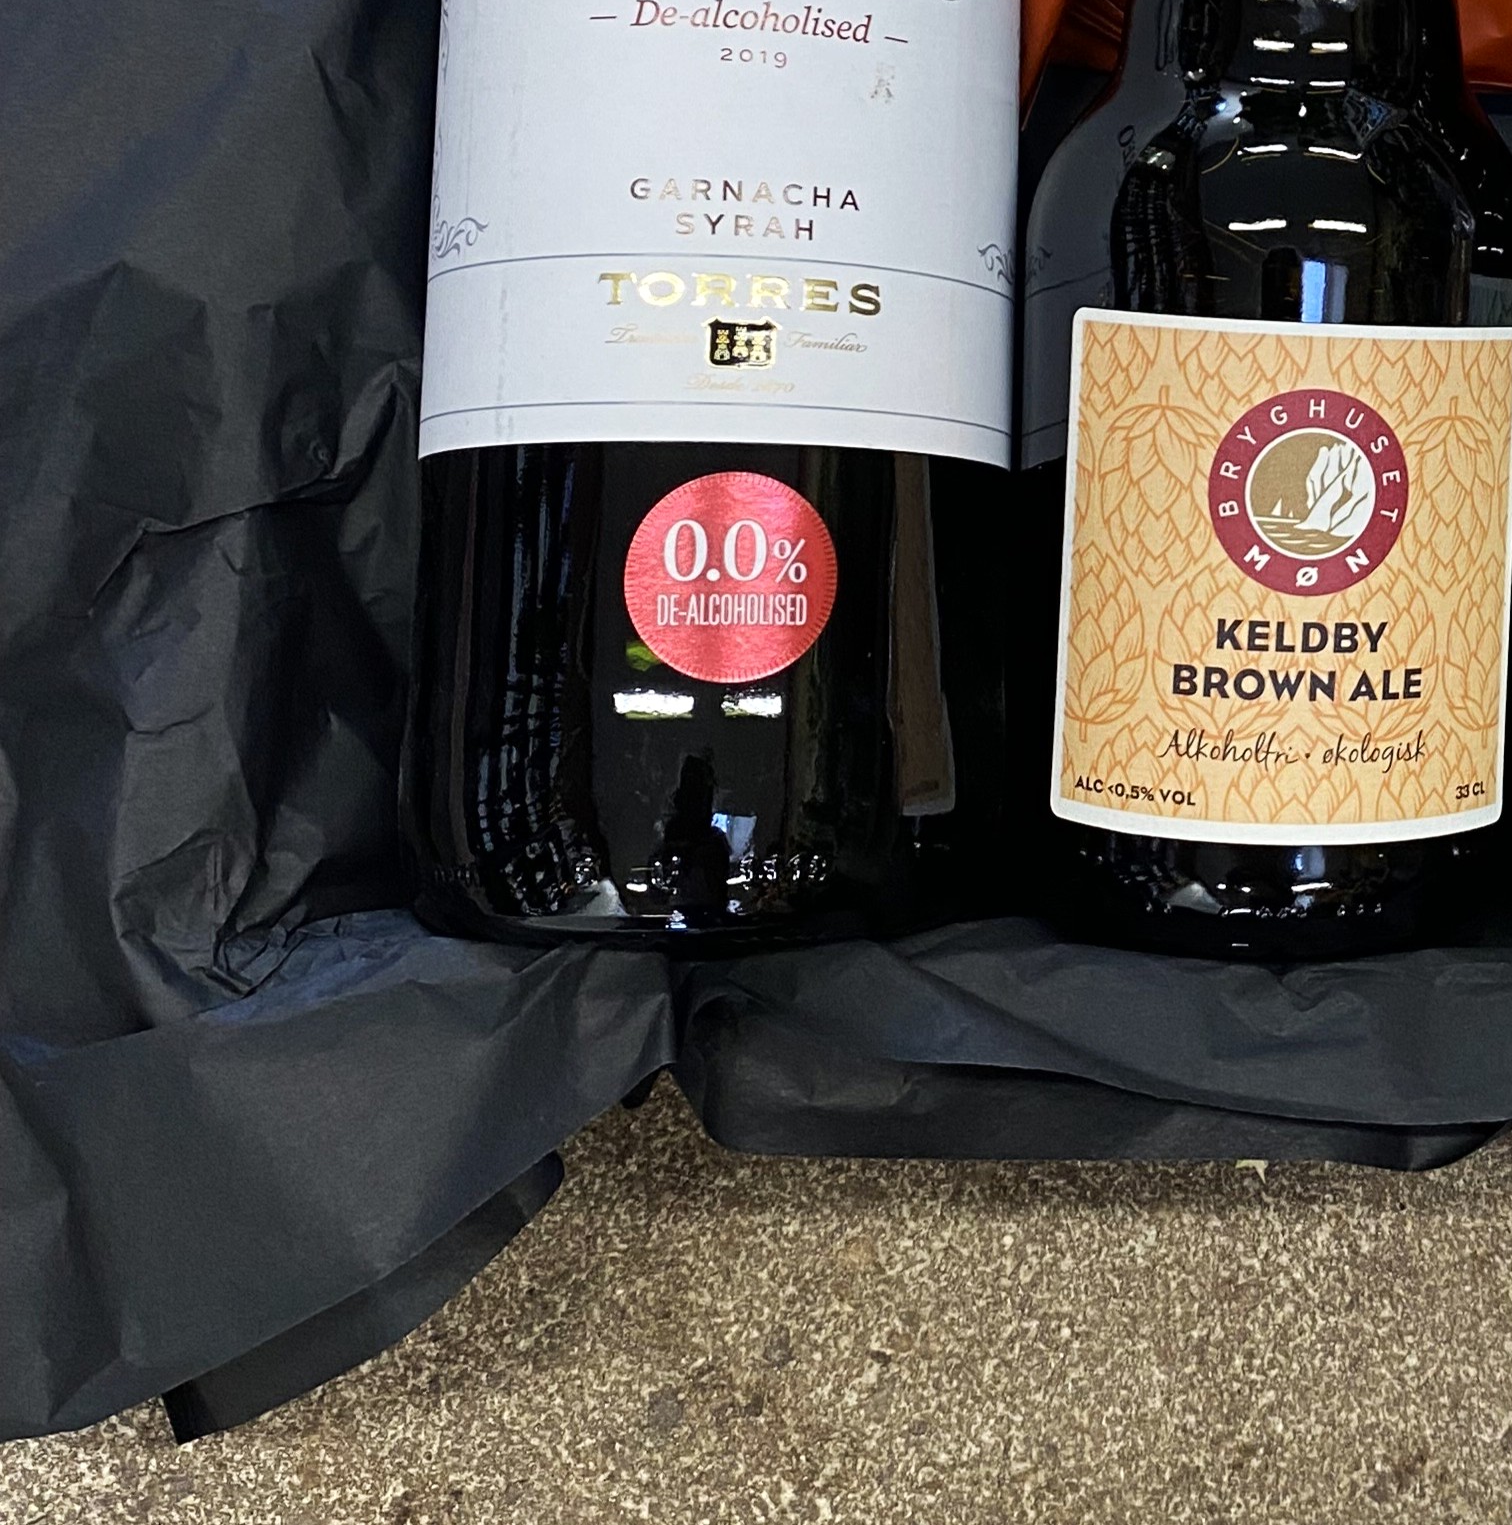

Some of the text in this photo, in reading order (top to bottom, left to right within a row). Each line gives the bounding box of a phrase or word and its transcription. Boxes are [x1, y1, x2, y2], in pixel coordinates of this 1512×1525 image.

[719, 47, 789, 69] 2019
[629, 177, 860, 212] GARNACHA
[675, 213, 815, 242] SYRAH
[597, 271, 883, 317] TORRES
[1218, 398, 1400, 523] BRYGHUSET
[663, 519, 807, 583] 0.0%
[1243, 548, 1371, 588] MØN
[656, 593, 807, 626] DE-ALCOHOLISED
[1215, 619, 1388, 654] KELDBY
[1172, 664, 1423, 703] BROWN ALE
[1322, 729, 1427, 774] økologisk
[1074, 775, 1104, 794] ALC
[1159, 789, 1197, 807] VOL
[1455, 781, 1486, 800] 33 CL
